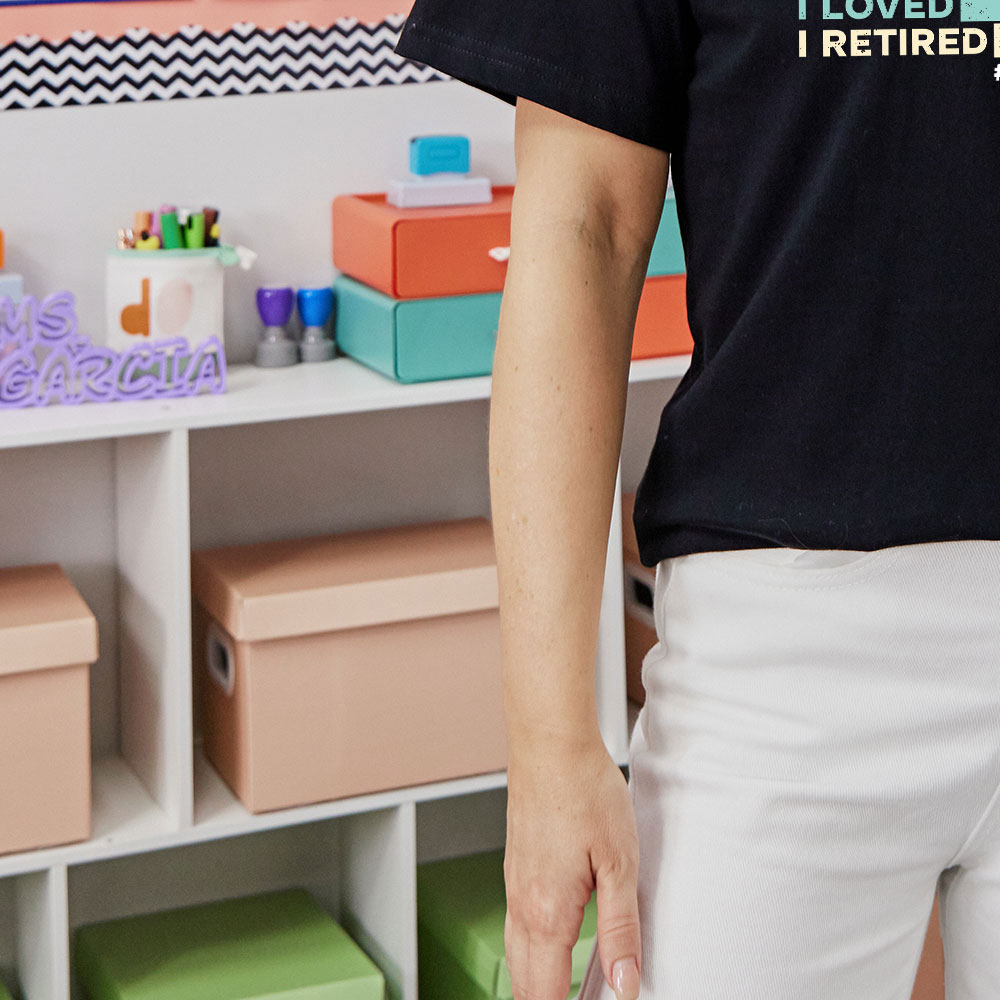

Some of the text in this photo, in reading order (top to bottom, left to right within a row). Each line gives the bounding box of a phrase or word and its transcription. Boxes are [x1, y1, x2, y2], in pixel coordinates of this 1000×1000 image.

[799, 28, 987, 57] I RETIRED
[0, 336, 226, 409] GARCIA
